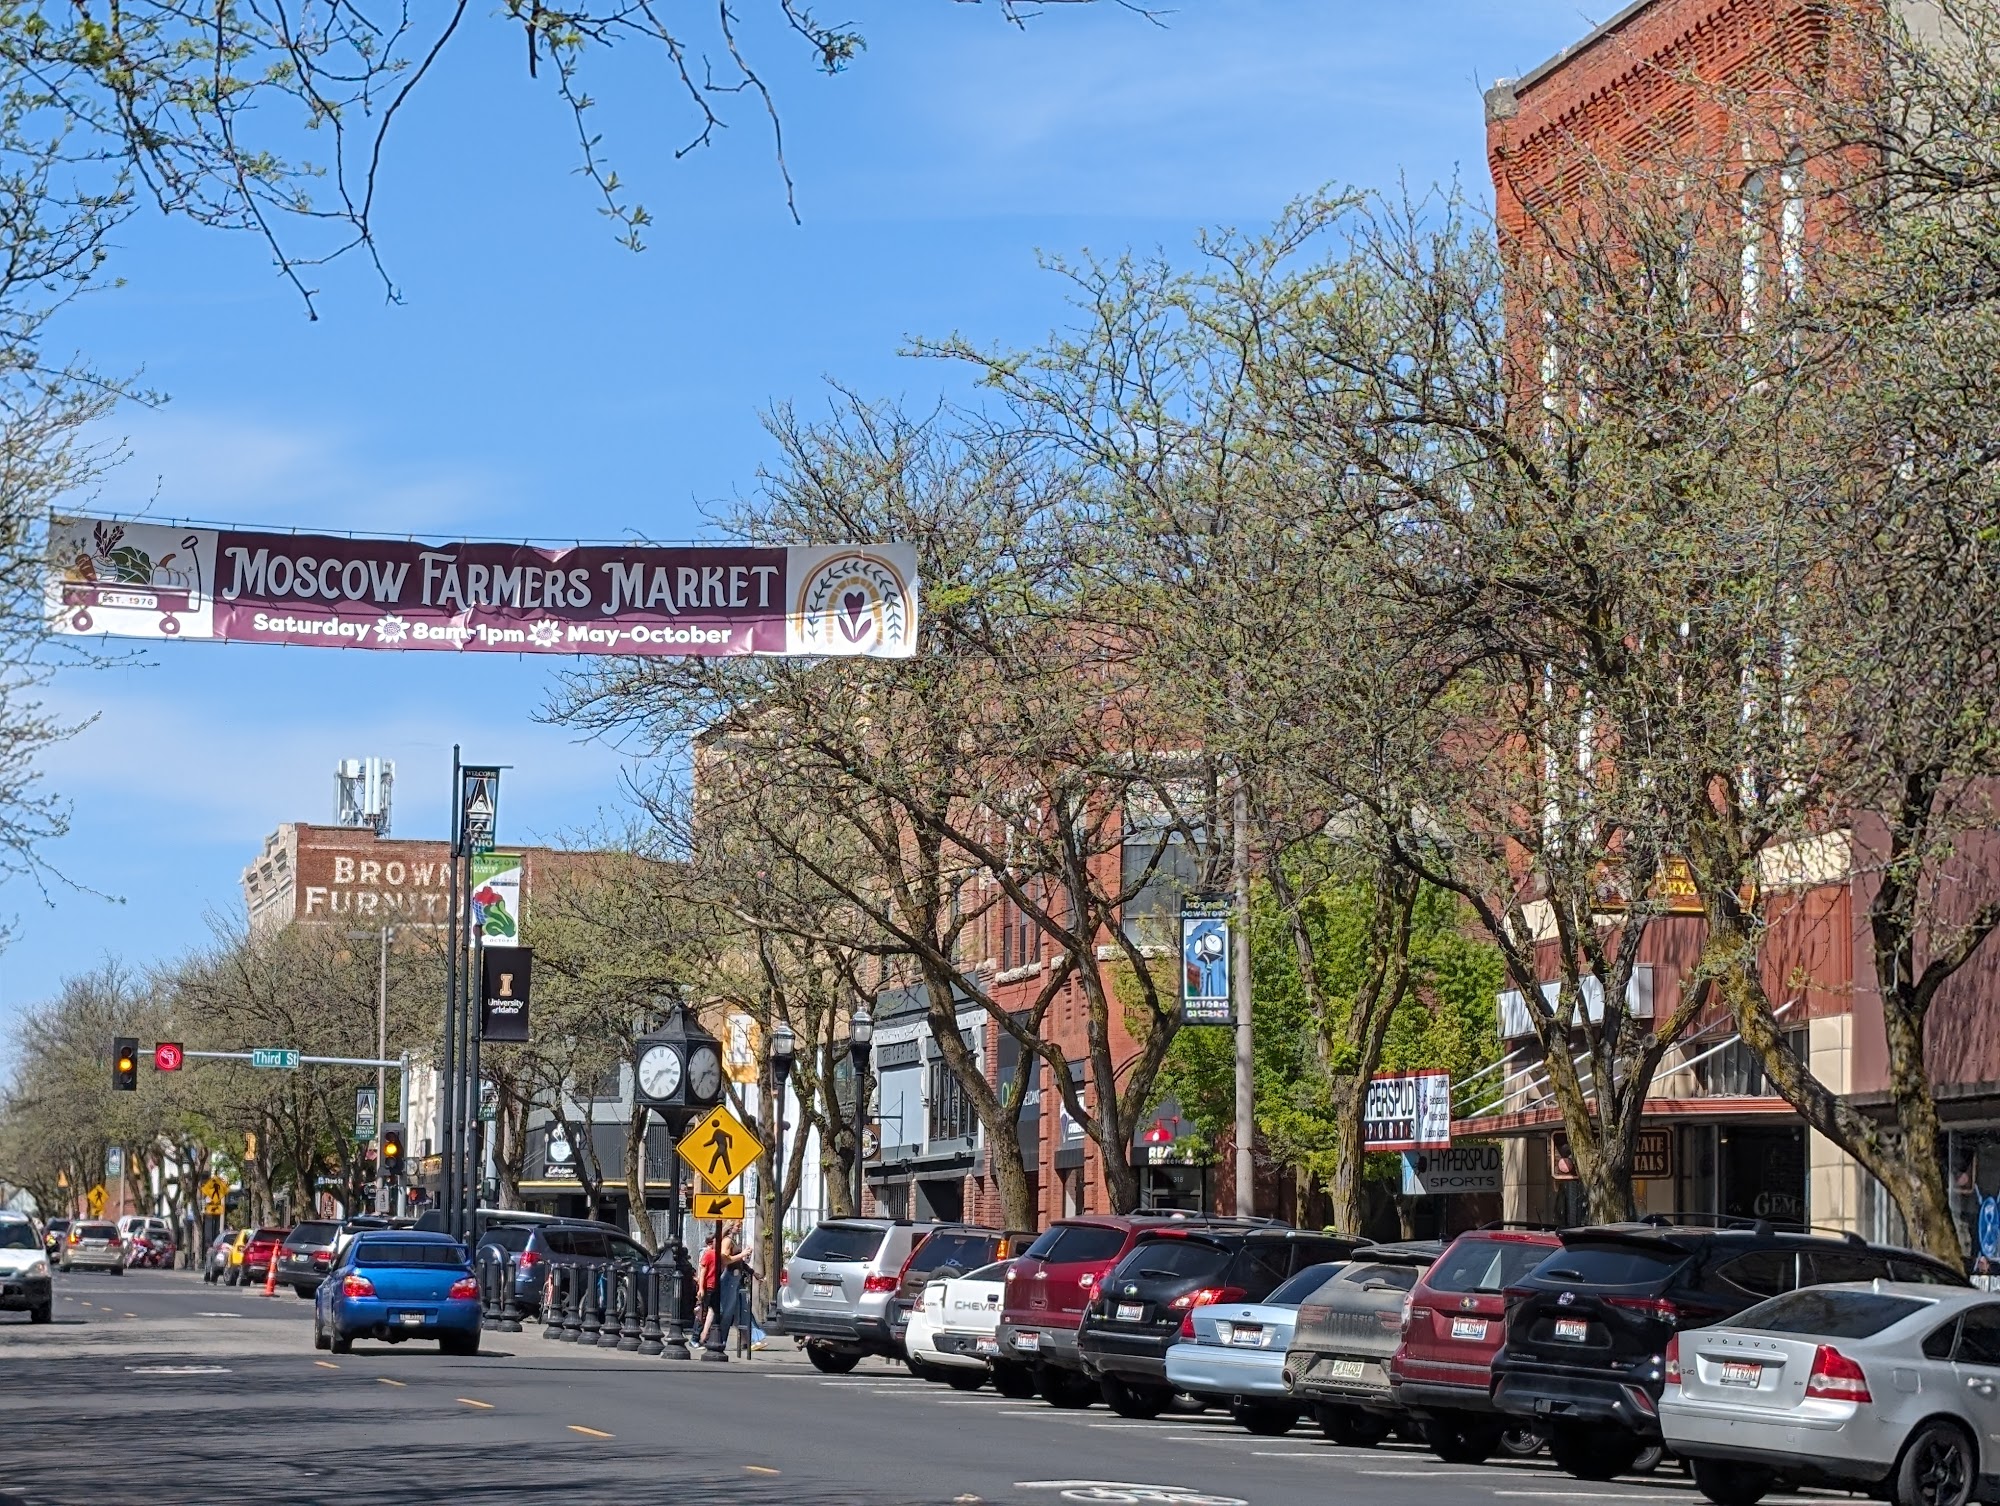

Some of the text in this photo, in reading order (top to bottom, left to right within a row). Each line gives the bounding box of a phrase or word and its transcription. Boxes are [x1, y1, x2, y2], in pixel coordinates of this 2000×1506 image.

[129, 597, 154, 606] 1976
[254, 613, 732, 647] Saturday 8am-1pm May-October
[488, 998, 524, 1009] University
[499, 1006, 519, 1014] Idaho
[255, 1051, 297, 1066] Third St
[1429, 1148, 1499, 1172] HYPERSPUD
[1430, 1176, 1496, 1187] SPORTS
[1707, 1338, 1777, 1350] VOLVO
